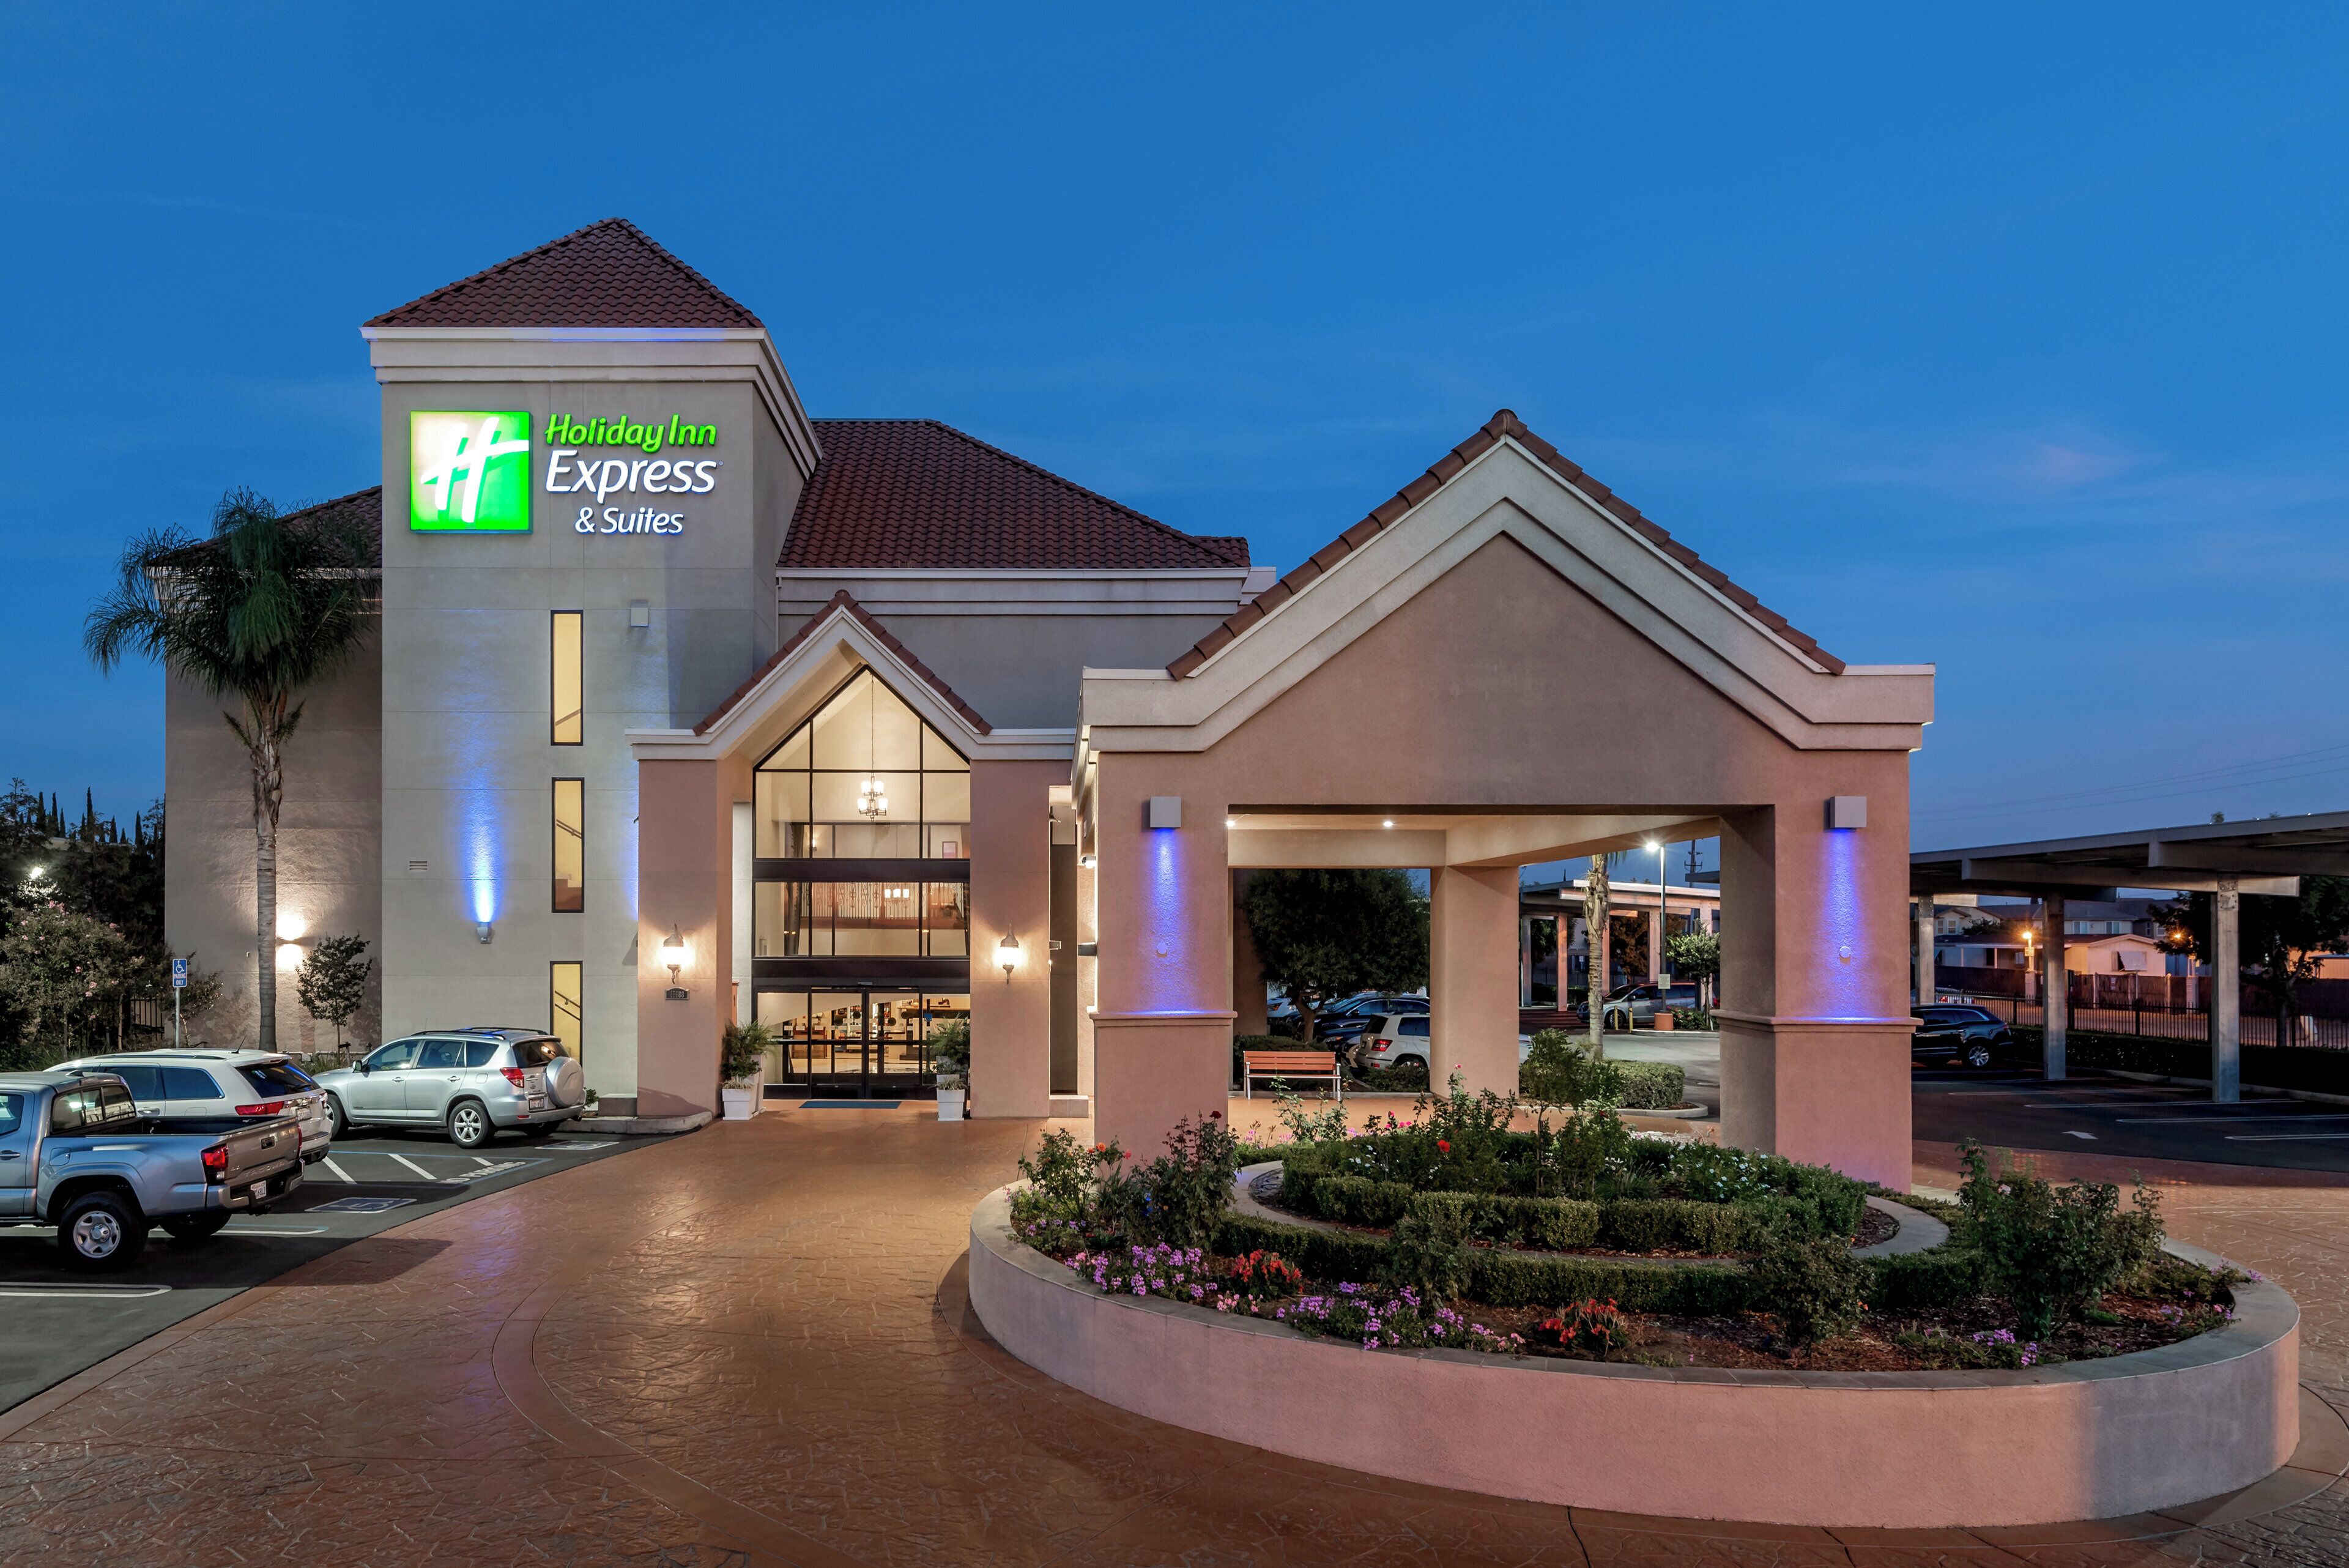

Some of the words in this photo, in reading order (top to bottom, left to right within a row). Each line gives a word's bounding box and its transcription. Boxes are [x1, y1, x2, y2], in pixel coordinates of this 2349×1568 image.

[544, 413, 665, 453] Holiday
[668, 414, 716, 446] Inn
[545, 450, 716, 505] Express
[574, 507, 595, 534] &
[600, 507, 684, 535] Suites
[459, 1162, 526, 1178] PARKING
